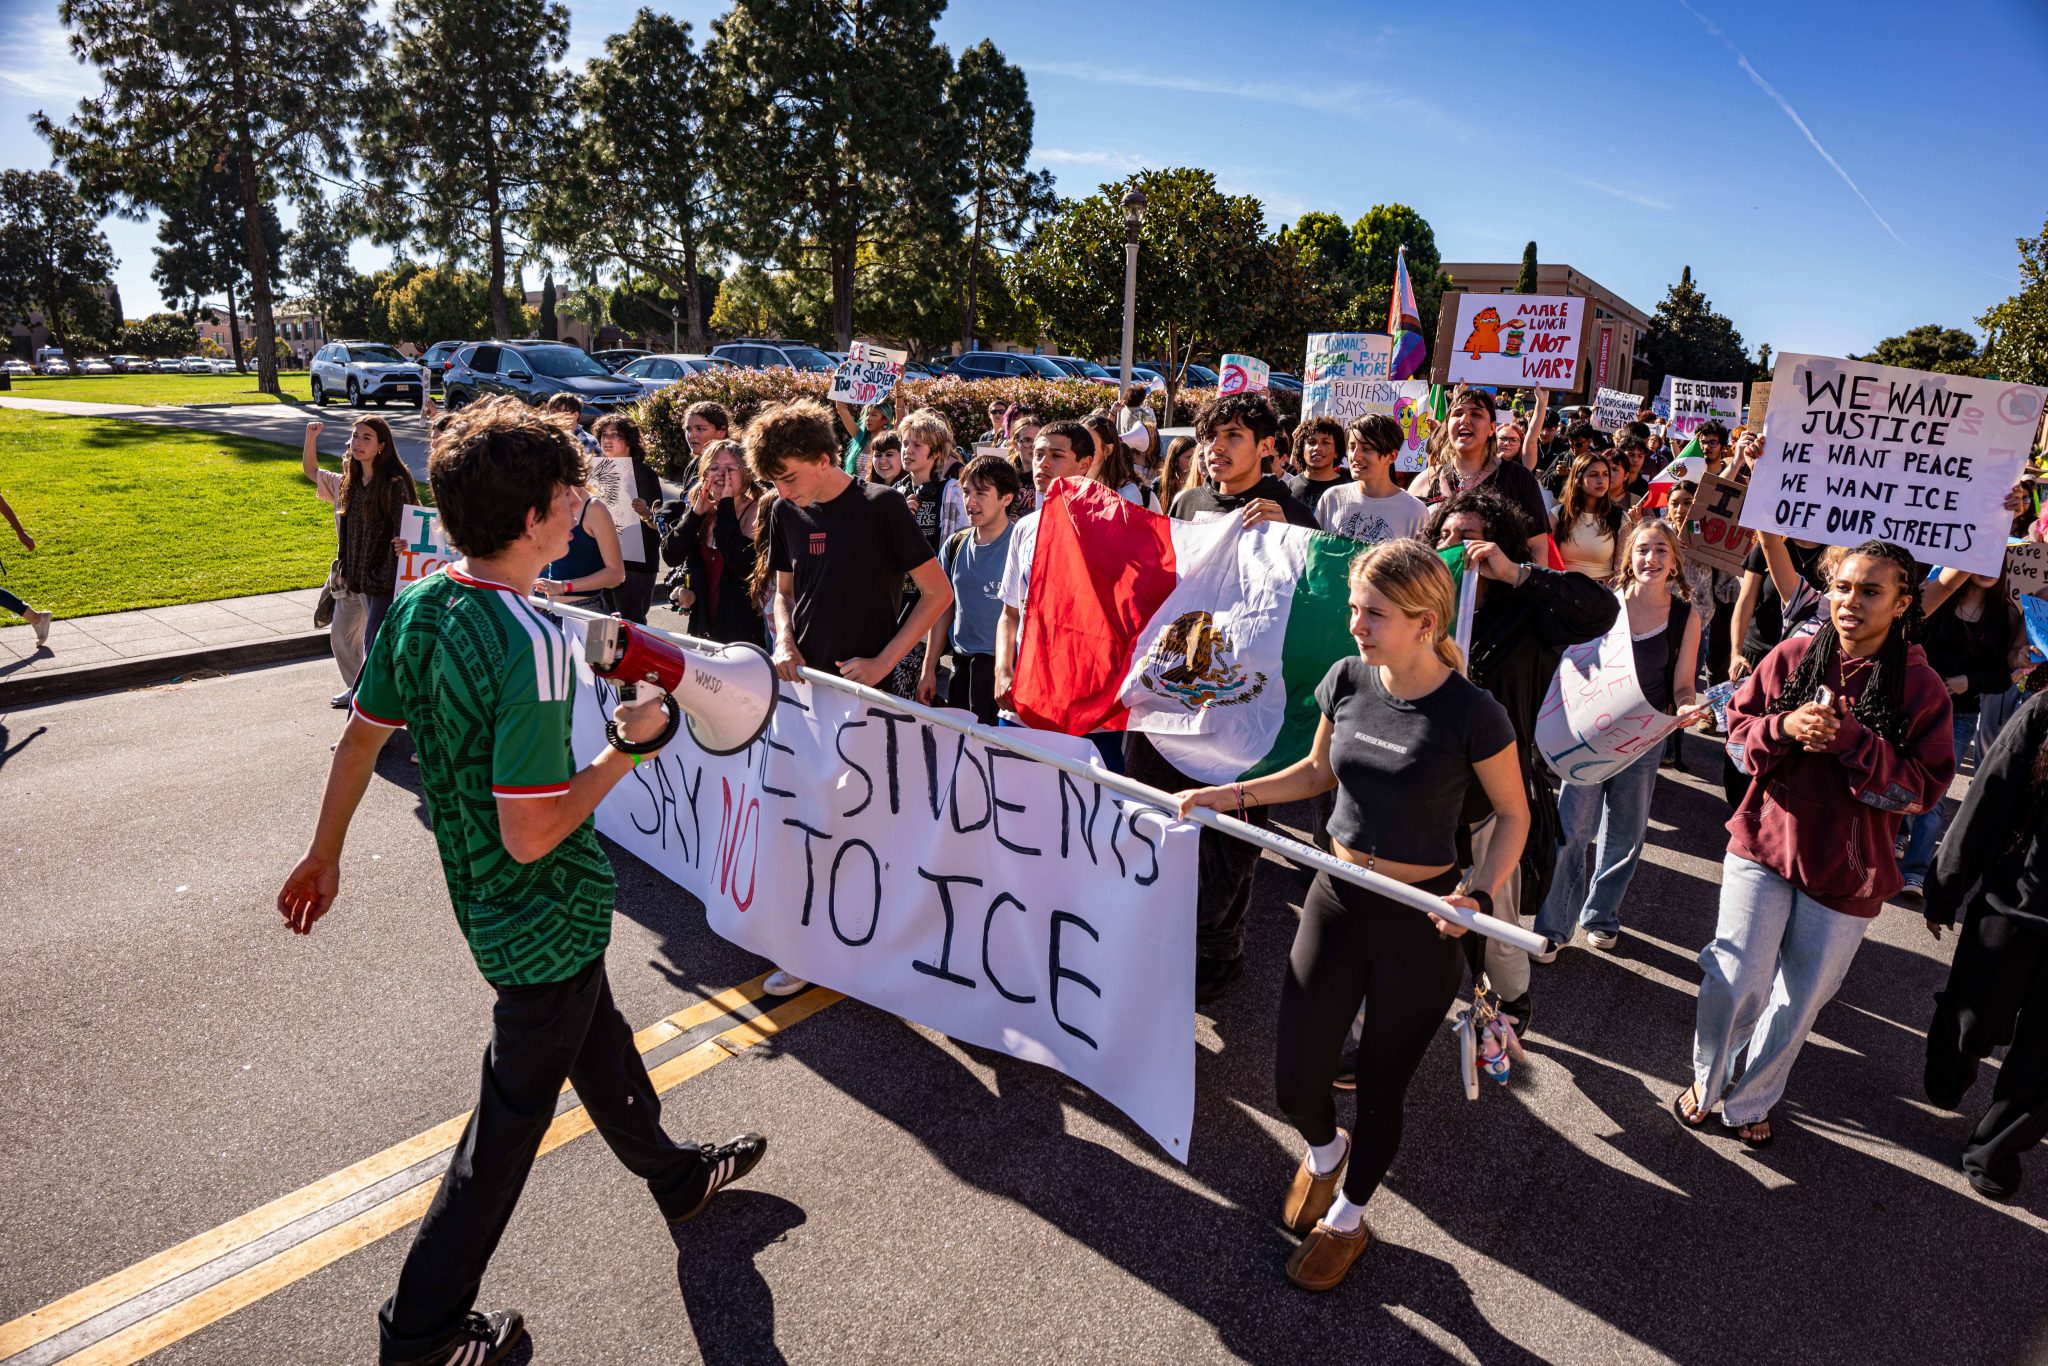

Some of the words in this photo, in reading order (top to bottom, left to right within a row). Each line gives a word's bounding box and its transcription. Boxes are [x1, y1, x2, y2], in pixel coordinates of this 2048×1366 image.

[1517, 303, 1568, 316] MAKE
[1529, 318, 1566, 330] LUNCH
[1325, 337, 1367, 351] ANIMALS
[1529, 333, 1571, 353] NOT
[1601, 333, 1609, 360] DISTRICT
[1314, 352, 1352, 365] EQUAL
[1360, 352, 1388, 361] BUT
[1523, 357, 1574, 378] WAR!
[853, 364, 861, 376] A
[862, 370, 896, 386] SOLDIER
[1325, 365, 1345, 378] ARE
[1353, 362, 1388, 377] MORE
[834, 376, 851, 391] TOO
[850, 381, 876, 402] STUPID
[1335, 382, 1404, 402] FLUTTERSHY
[1675, 382, 1692, 395] ICE
[1696, 384, 1737, 399] BELONGS
[1805, 371, 1878, 410] WE
[1888, 381, 1973, 418] WANT
[1336, 398, 1367, 416] SAYS
[1598, 396, 1621, 409] WORKS
[1675, 399, 1691, 411] IN
[1694, 399, 1710, 414] MY
[1596, 407, 1613, 418] THAN
[1614, 409, 1635, 420] YOUR
[1802, 411, 1949, 446] JUSTICE
[1782, 442, 1814, 463] WE
[1828, 444, 1891, 468] WANT
[1904, 452, 1973, 482] PEACE,
[1781, 474, 1808, 492] WE
[1826, 477, 1898, 503] WANT
[1904, 485, 1959, 511] ICE
[1776, 500, 1821, 527] OFF
[1826, 506, 1876, 534] OUR
[1879, 517, 1976, 552] STREETS
[695, 669, 722, 694] WMSD
[630, 754, 702, 869] SAY
[711, 776, 760, 912] NO
[783, 818, 881, 946] TO
[912, 866, 1101, 1050] ICE
